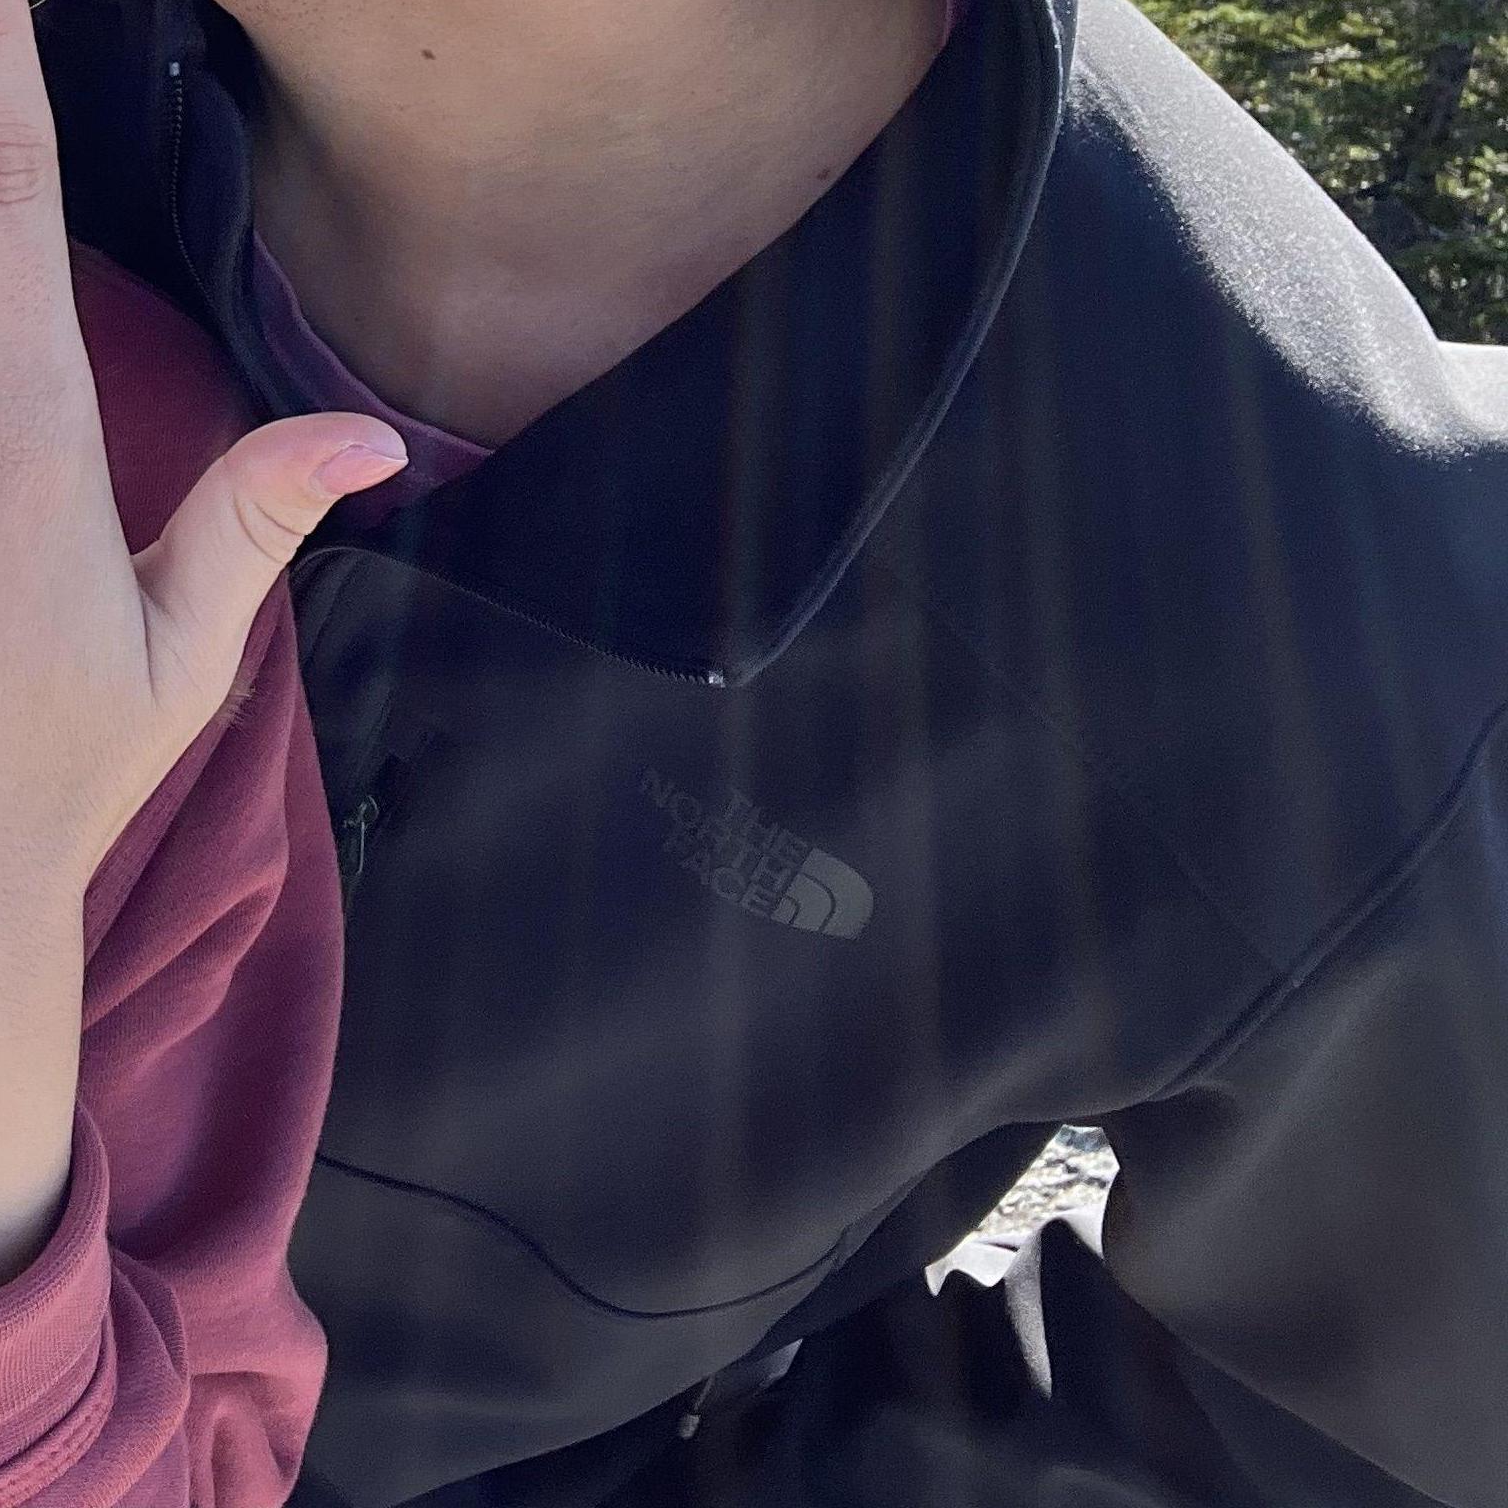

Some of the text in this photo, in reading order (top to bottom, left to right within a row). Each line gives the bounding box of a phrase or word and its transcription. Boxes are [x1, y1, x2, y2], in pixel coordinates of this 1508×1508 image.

[639, 767, 792, 892] NORTH
[724, 785, 808, 868] THE
[662, 827, 779, 919] FACE
